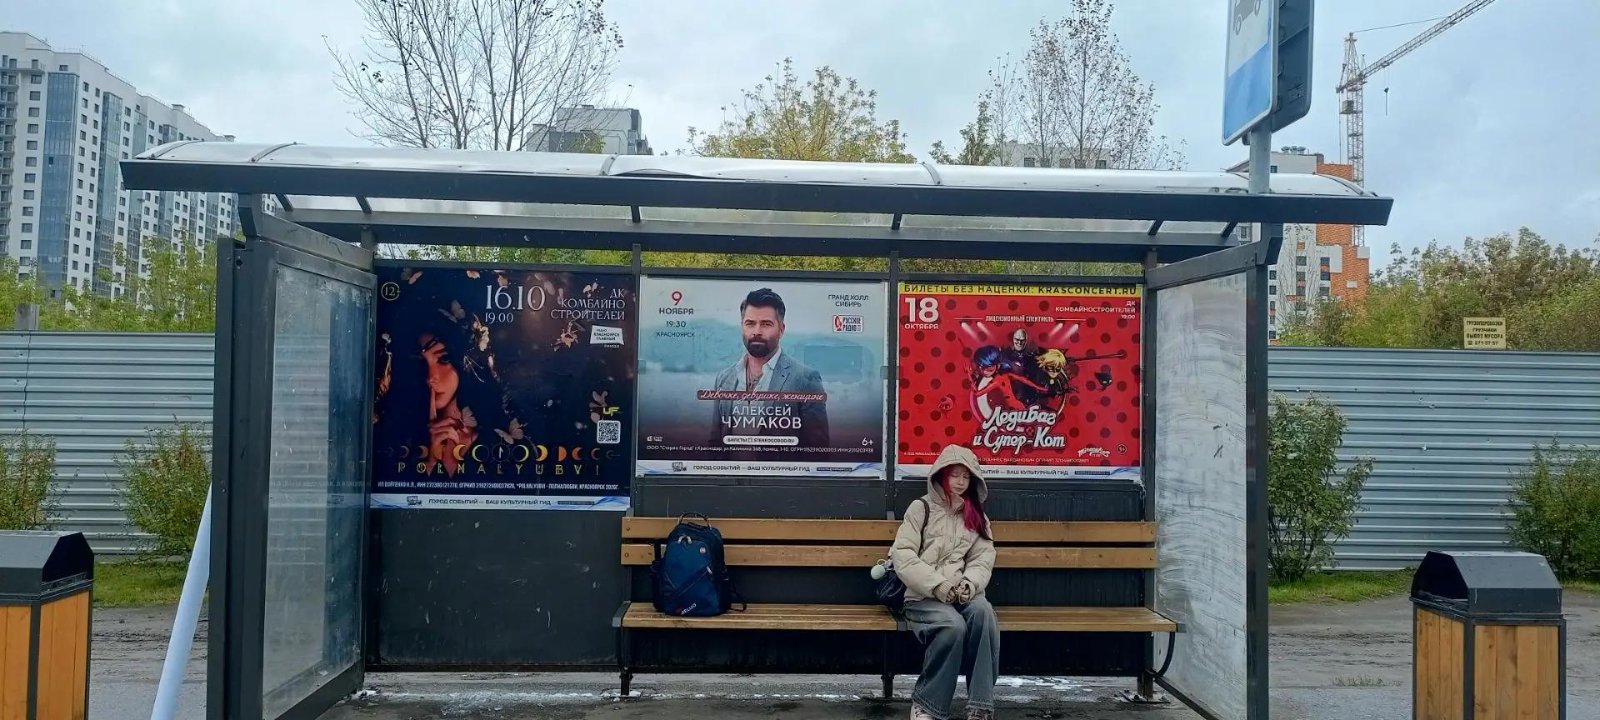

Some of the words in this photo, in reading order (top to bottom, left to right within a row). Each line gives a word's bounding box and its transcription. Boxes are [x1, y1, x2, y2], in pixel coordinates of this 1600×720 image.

[610, 288, 625, 299] ДК
[953, 285, 973, 293] БЕЗ
[978, 286, 1034, 294] НАЦЕНКИ:
[1038, 287, 1136, 295] KRASCONCERT.RU
[485, 285, 546, 311] 16.10
[671, 291, 682, 306] 9
[828, 294, 849, 302] ГРАНД
[904, 297, 939, 323] 18
[732, 403, 792, 416] АЛЕКСЕЙ
[721, 416, 802, 429] ЧУМАКОВ
[982, 406, 1057, 431] Ледибаг
[861, 437, 874, 446] 6+
[973, 436, 982, 446] и
[984, 425, 1066, 455] Супер-Кот
